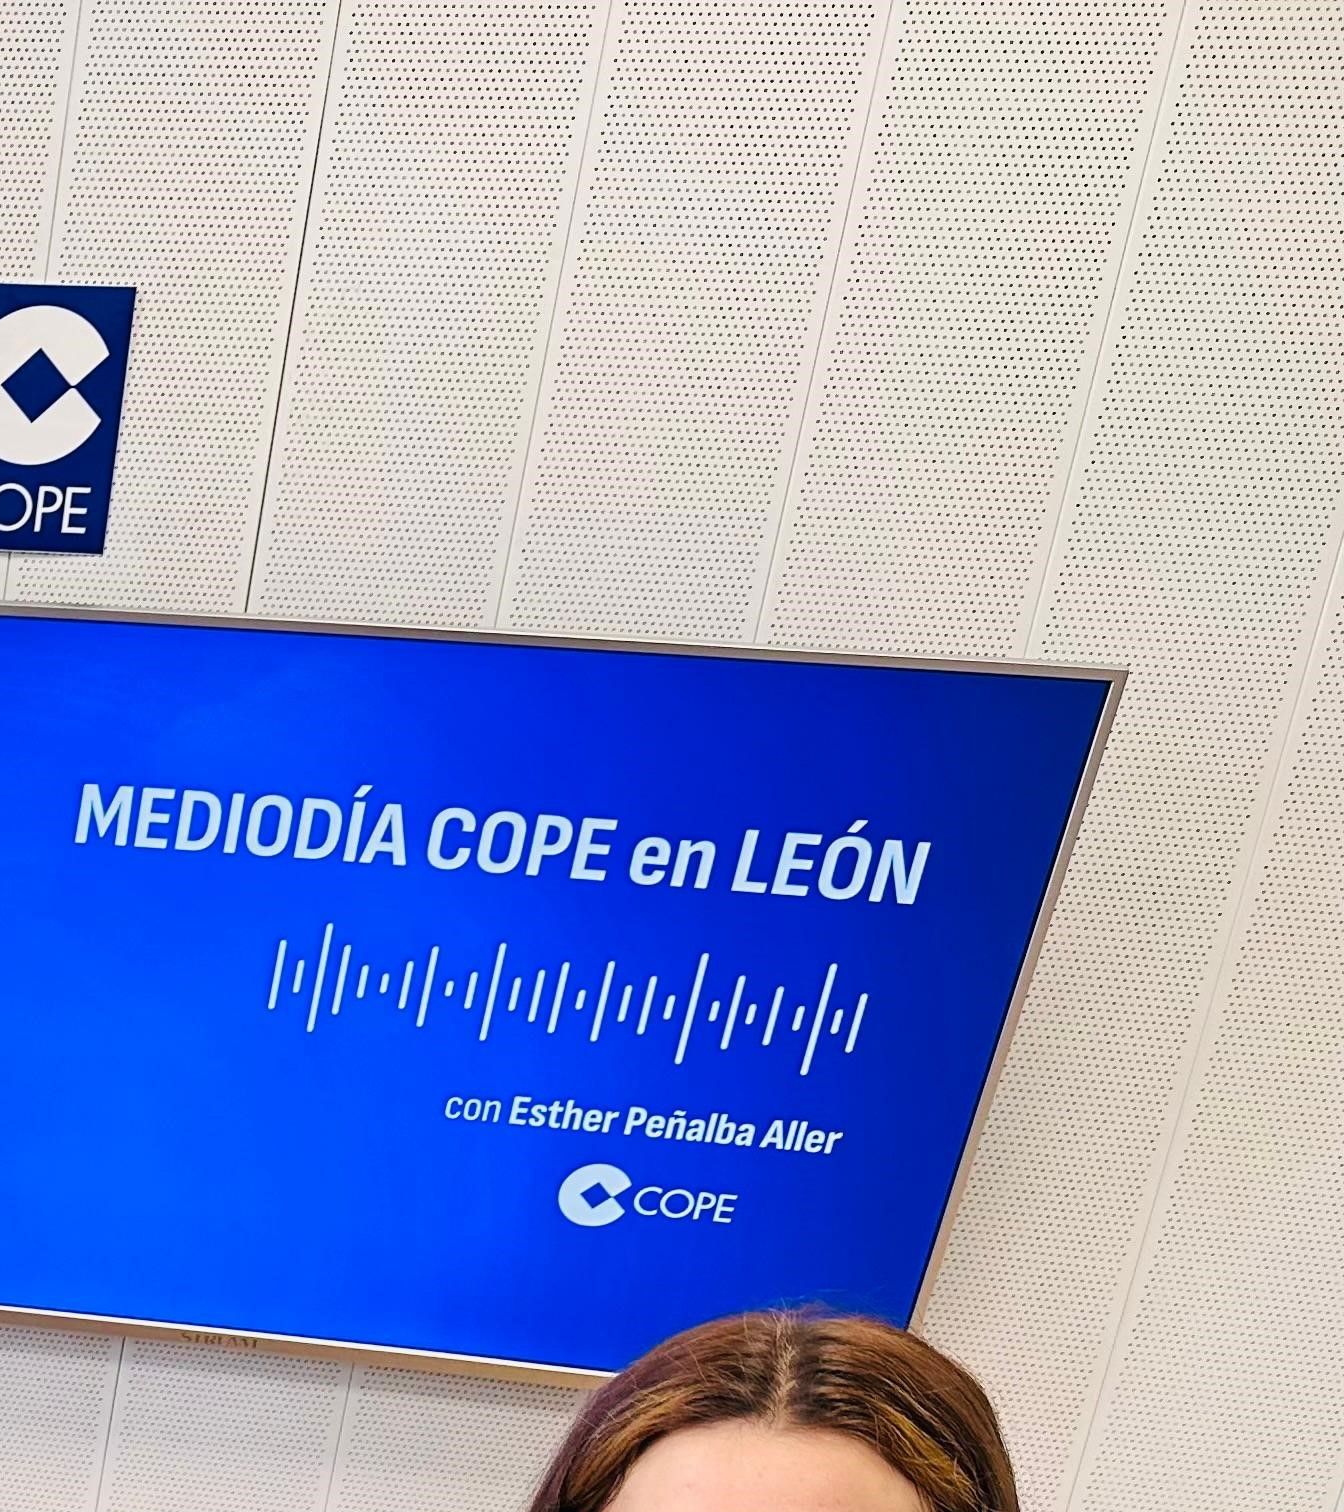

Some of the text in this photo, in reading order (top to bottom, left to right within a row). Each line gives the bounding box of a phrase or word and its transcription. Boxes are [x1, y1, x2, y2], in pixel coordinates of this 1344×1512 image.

[74, 783, 931, 905] MEDIODÍA COPE en LEÓN
[444, 1095, 843, 1154] con Esther Peñalba Aller
[633, 1186, 738, 1223] COPE
